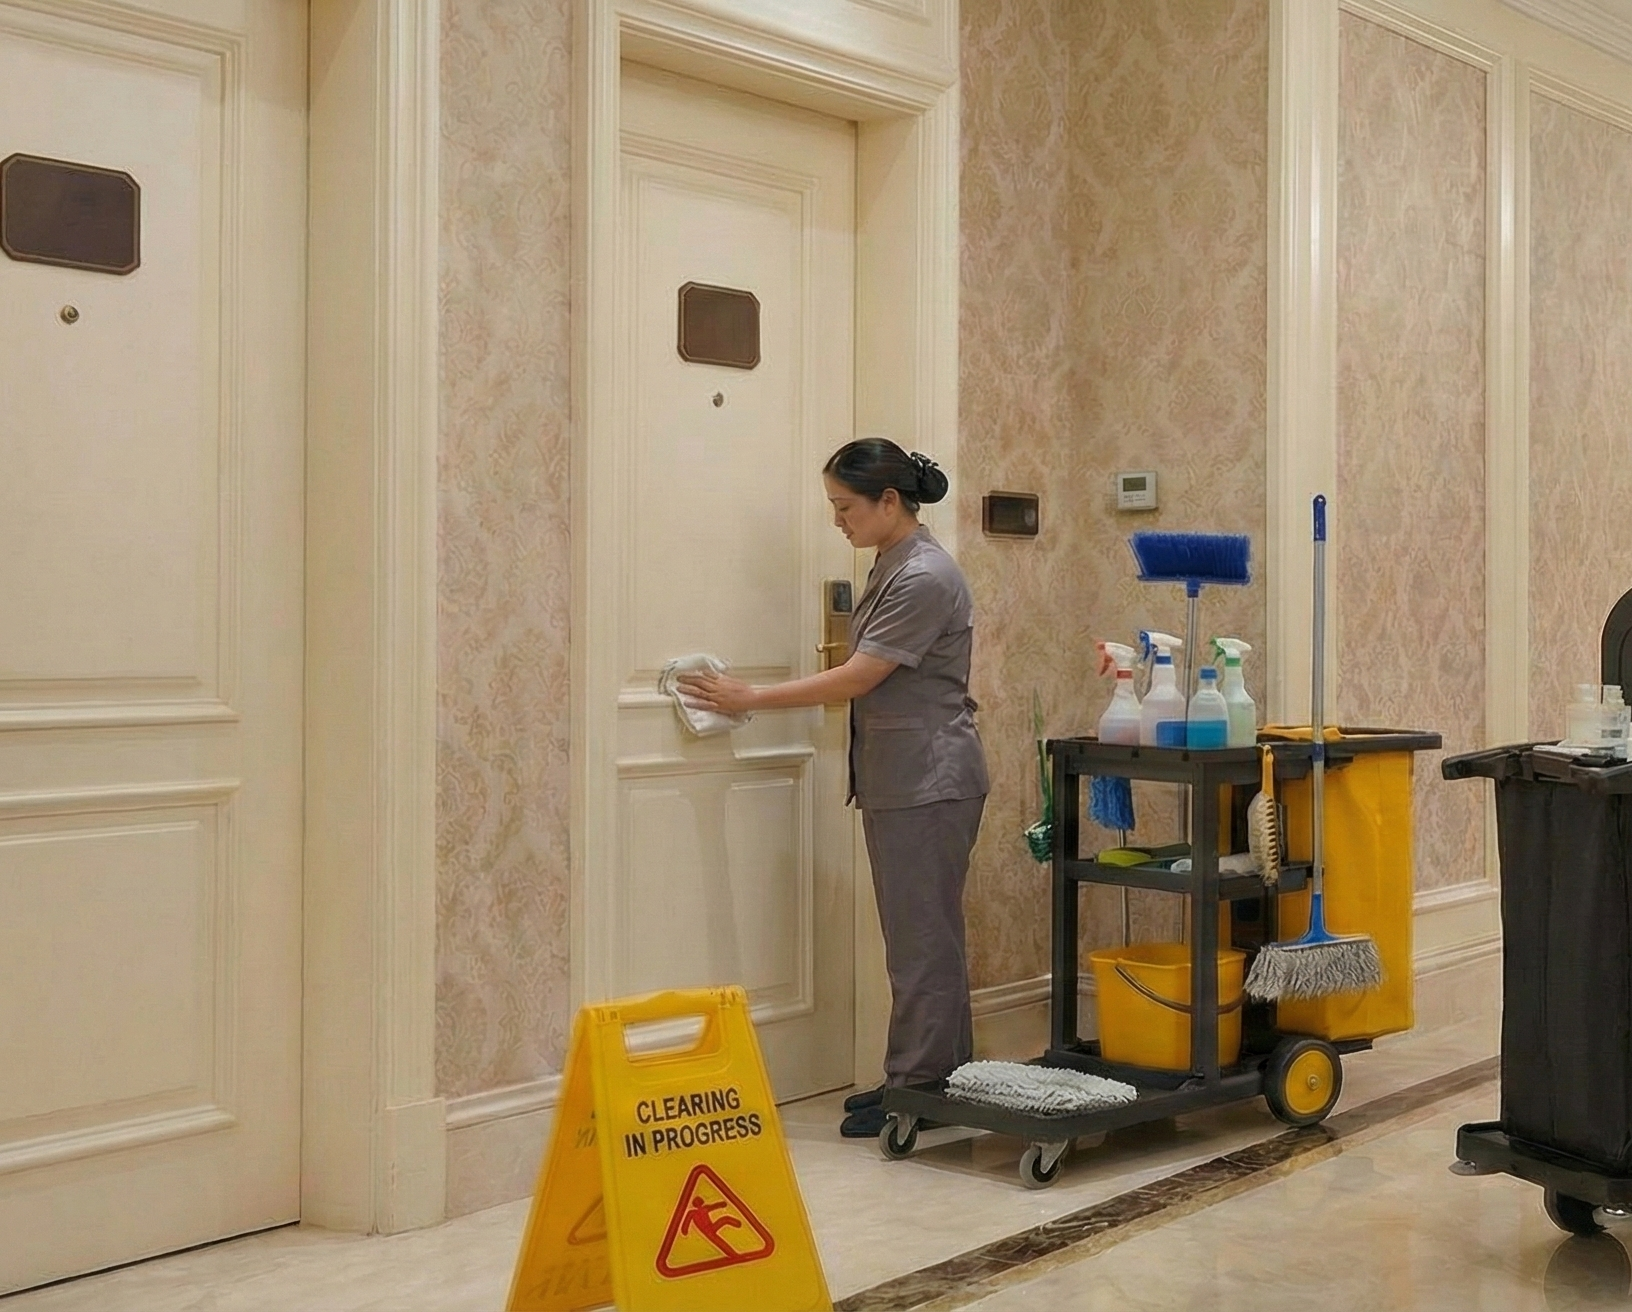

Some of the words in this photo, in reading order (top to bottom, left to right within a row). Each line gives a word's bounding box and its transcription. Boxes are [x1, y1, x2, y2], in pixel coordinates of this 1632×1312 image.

[636, 1087, 741, 1125] CLEARING
[624, 1132, 647, 1158] IN
[651, 1113, 762, 1153] PROGRESS
